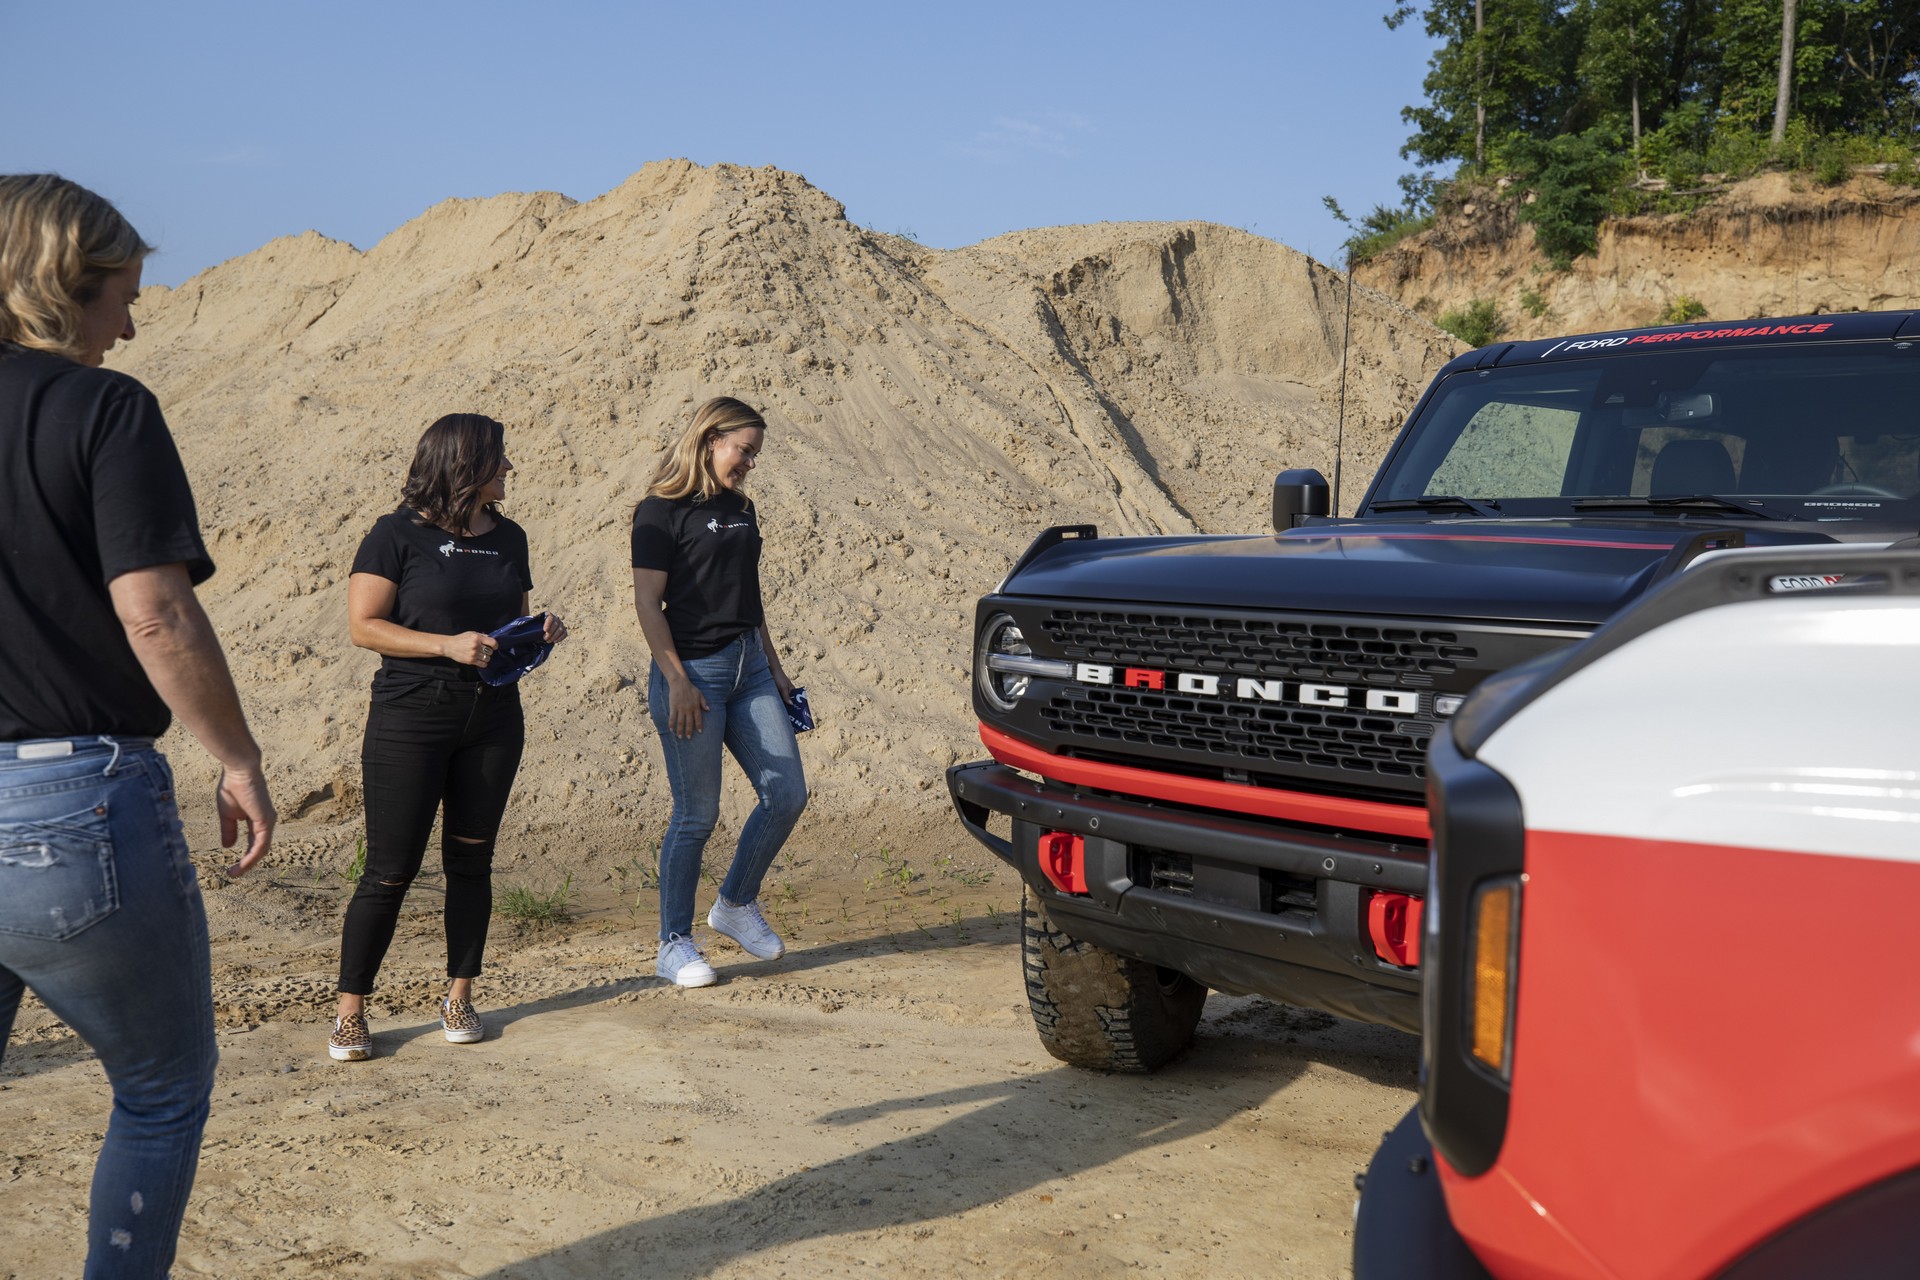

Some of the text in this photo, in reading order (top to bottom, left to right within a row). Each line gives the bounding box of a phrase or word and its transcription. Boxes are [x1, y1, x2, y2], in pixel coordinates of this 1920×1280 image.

[1564, 323, 1834, 351] FORD PERFORMANCE
[456, 548, 498, 556] BRONCO
[1076, 662, 1419, 714] BRONCO
